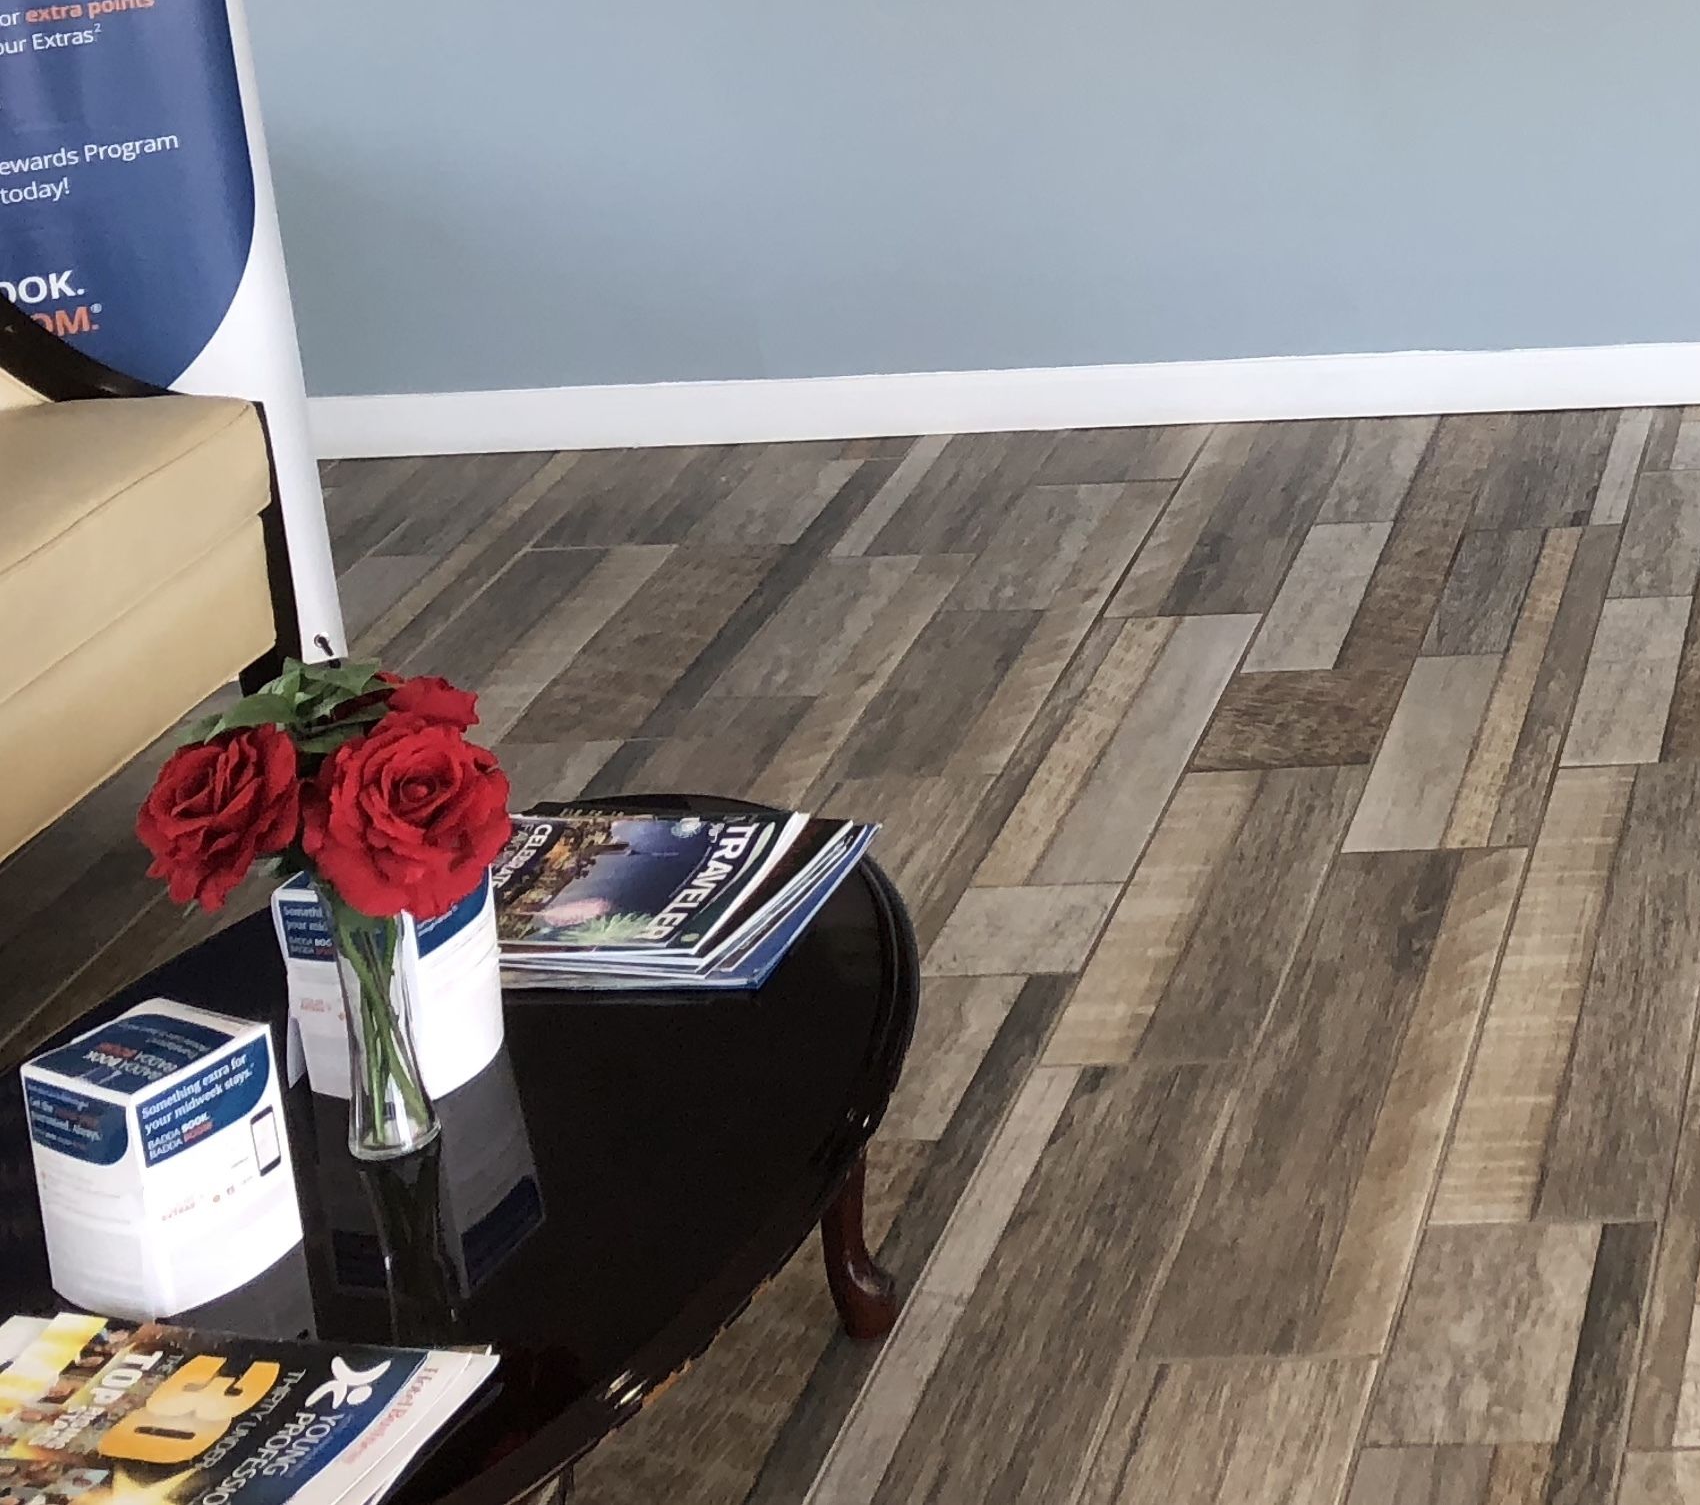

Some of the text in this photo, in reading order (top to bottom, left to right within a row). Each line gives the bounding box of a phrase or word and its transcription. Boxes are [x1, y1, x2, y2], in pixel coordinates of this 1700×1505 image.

[25, 3, 83, 24] extra
[84, 134, 179, 163] Program
[0, 177, 70, 205] today!
[633, 822, 760, 940] TRAVELER
[283, 905, 323, 918] Somethi
[142, 1054, 247, 1120] Something extra for
[145, 1111, 173, 1136] your
[174, 1083, 223, 1120] midweek
[99, 1354, 281, 1464] 30
[262, 1413, 345, 1477] YOUNG
